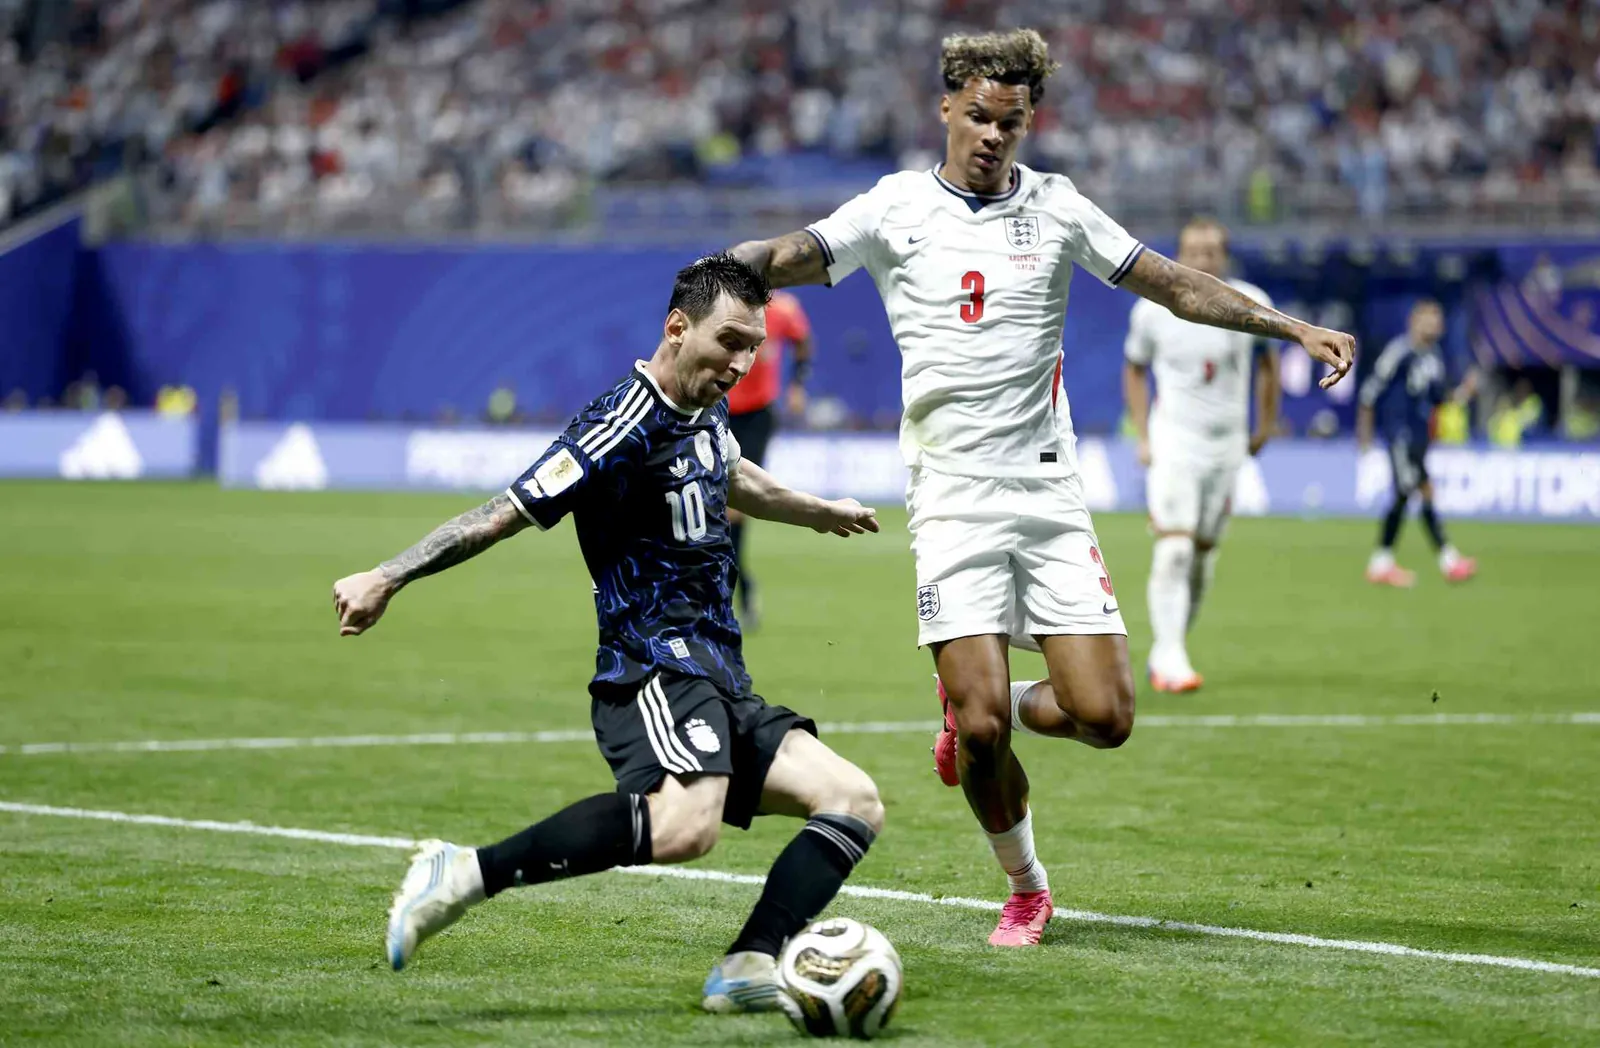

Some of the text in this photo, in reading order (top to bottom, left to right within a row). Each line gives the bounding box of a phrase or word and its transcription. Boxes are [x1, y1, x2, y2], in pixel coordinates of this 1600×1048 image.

[1008, 254, 1042, 263] ARGENTINA
[960, 270, 985, 323] 3
[664, 481, 707, 541] 10
[1089, 546, 1114, 596] 3
